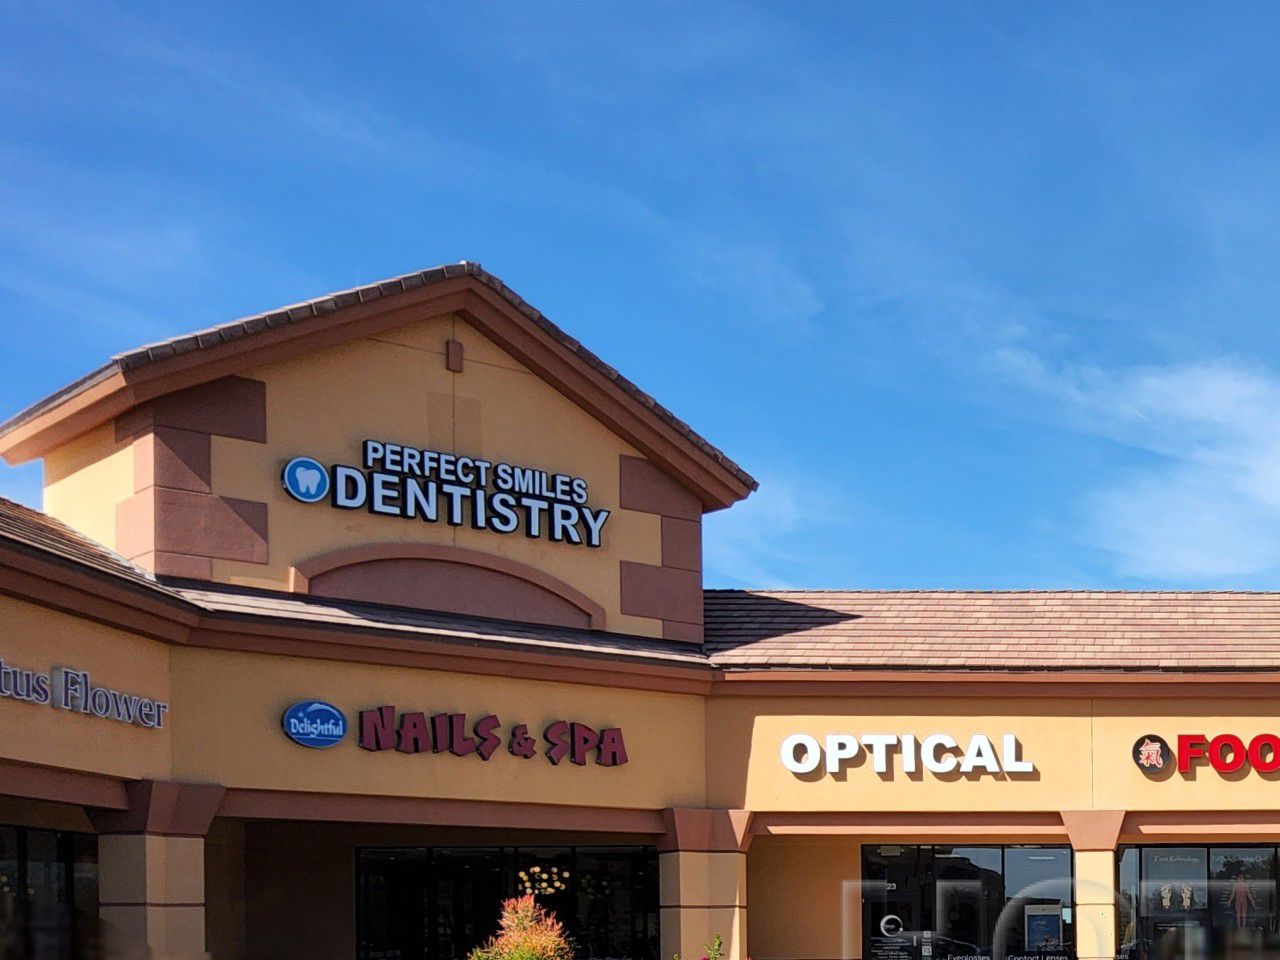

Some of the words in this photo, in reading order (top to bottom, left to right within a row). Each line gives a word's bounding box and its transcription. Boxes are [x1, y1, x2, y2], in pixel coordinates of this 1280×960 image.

[363, 440, 491, 487] PERFECT
[494, 463, 588, 504] SMILES
[331, 463, 611, 547] DENTISTRY
[54, 666, 168, 728] Flower
[290, 718, 343, 738] Delightful
[359, 705, 501, 761] NAILS
[509, 724, 536, 758] &
[543, 720, 629, 767] SPA
[781, 733, 1034, 774] OPTICAL
